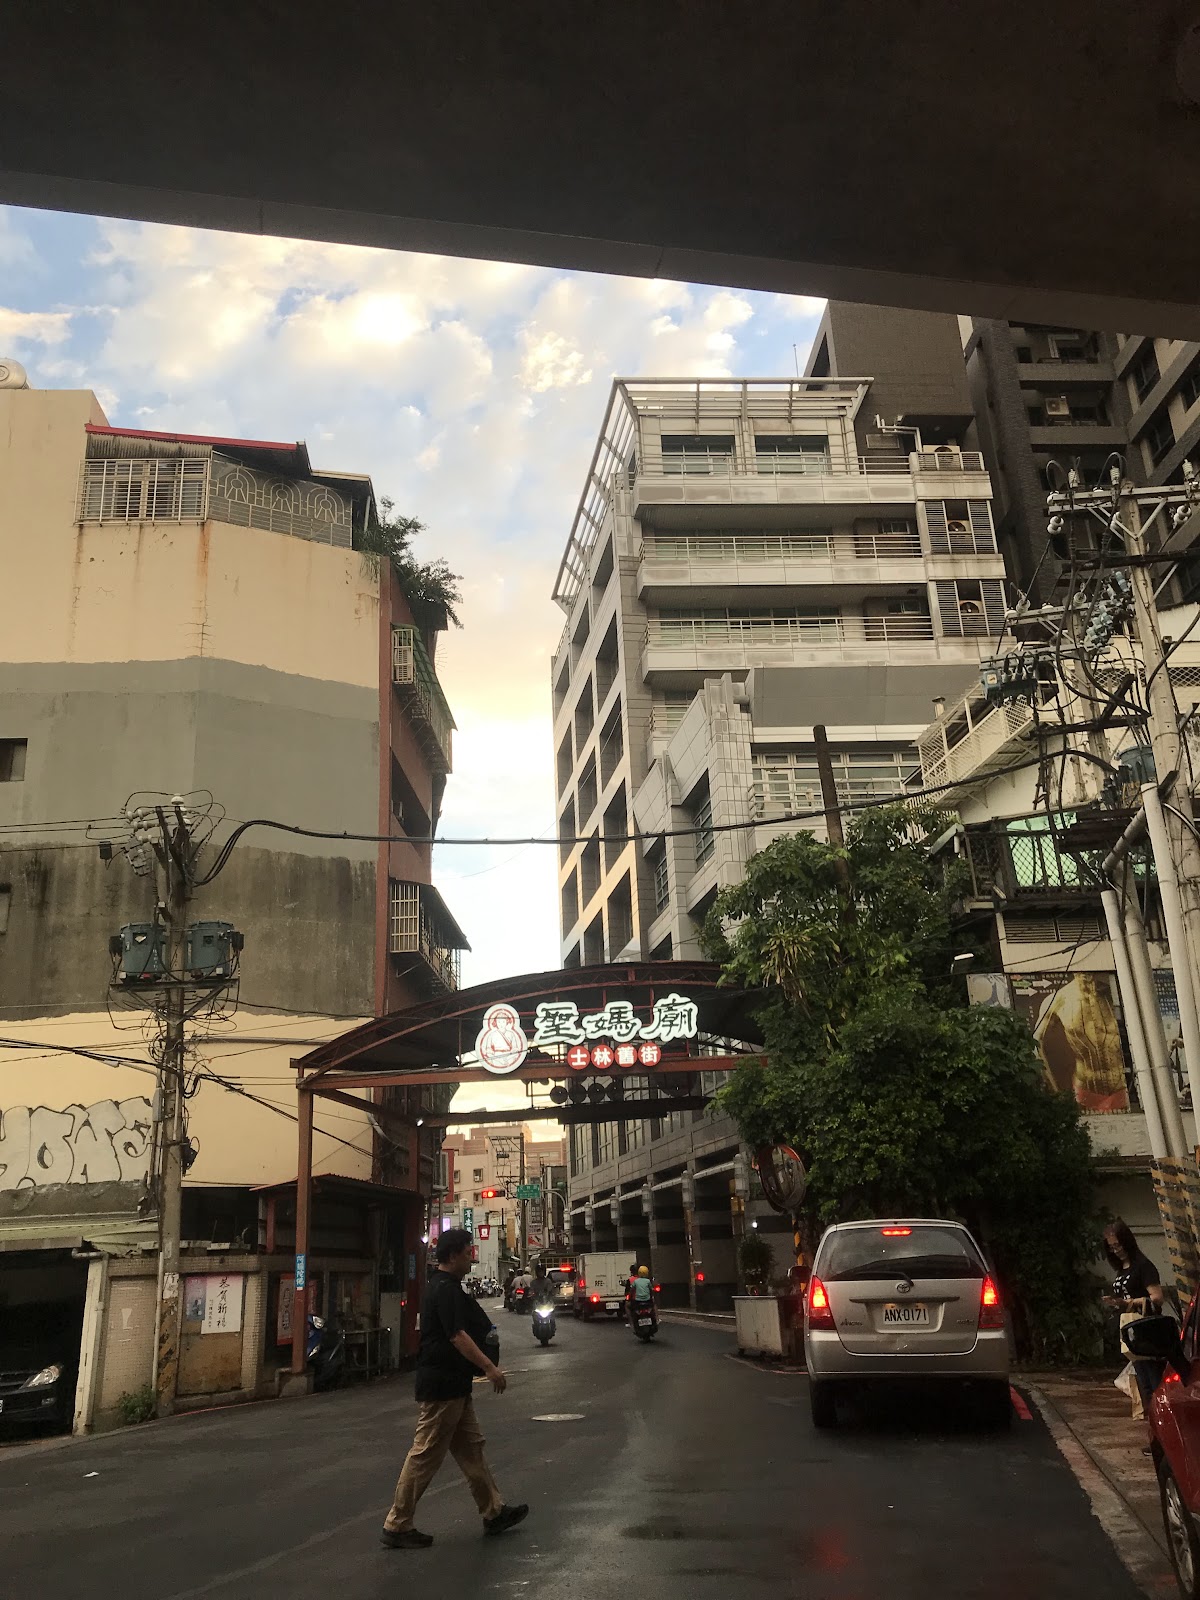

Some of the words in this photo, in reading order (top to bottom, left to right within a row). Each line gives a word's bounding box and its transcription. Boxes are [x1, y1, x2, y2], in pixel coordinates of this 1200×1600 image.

[538, 998, 693, 1040] 聖媽廟
[570, 1045, 659, 1065] 士林舊街
[884, 1308, 927, 1322] ANX-0171
